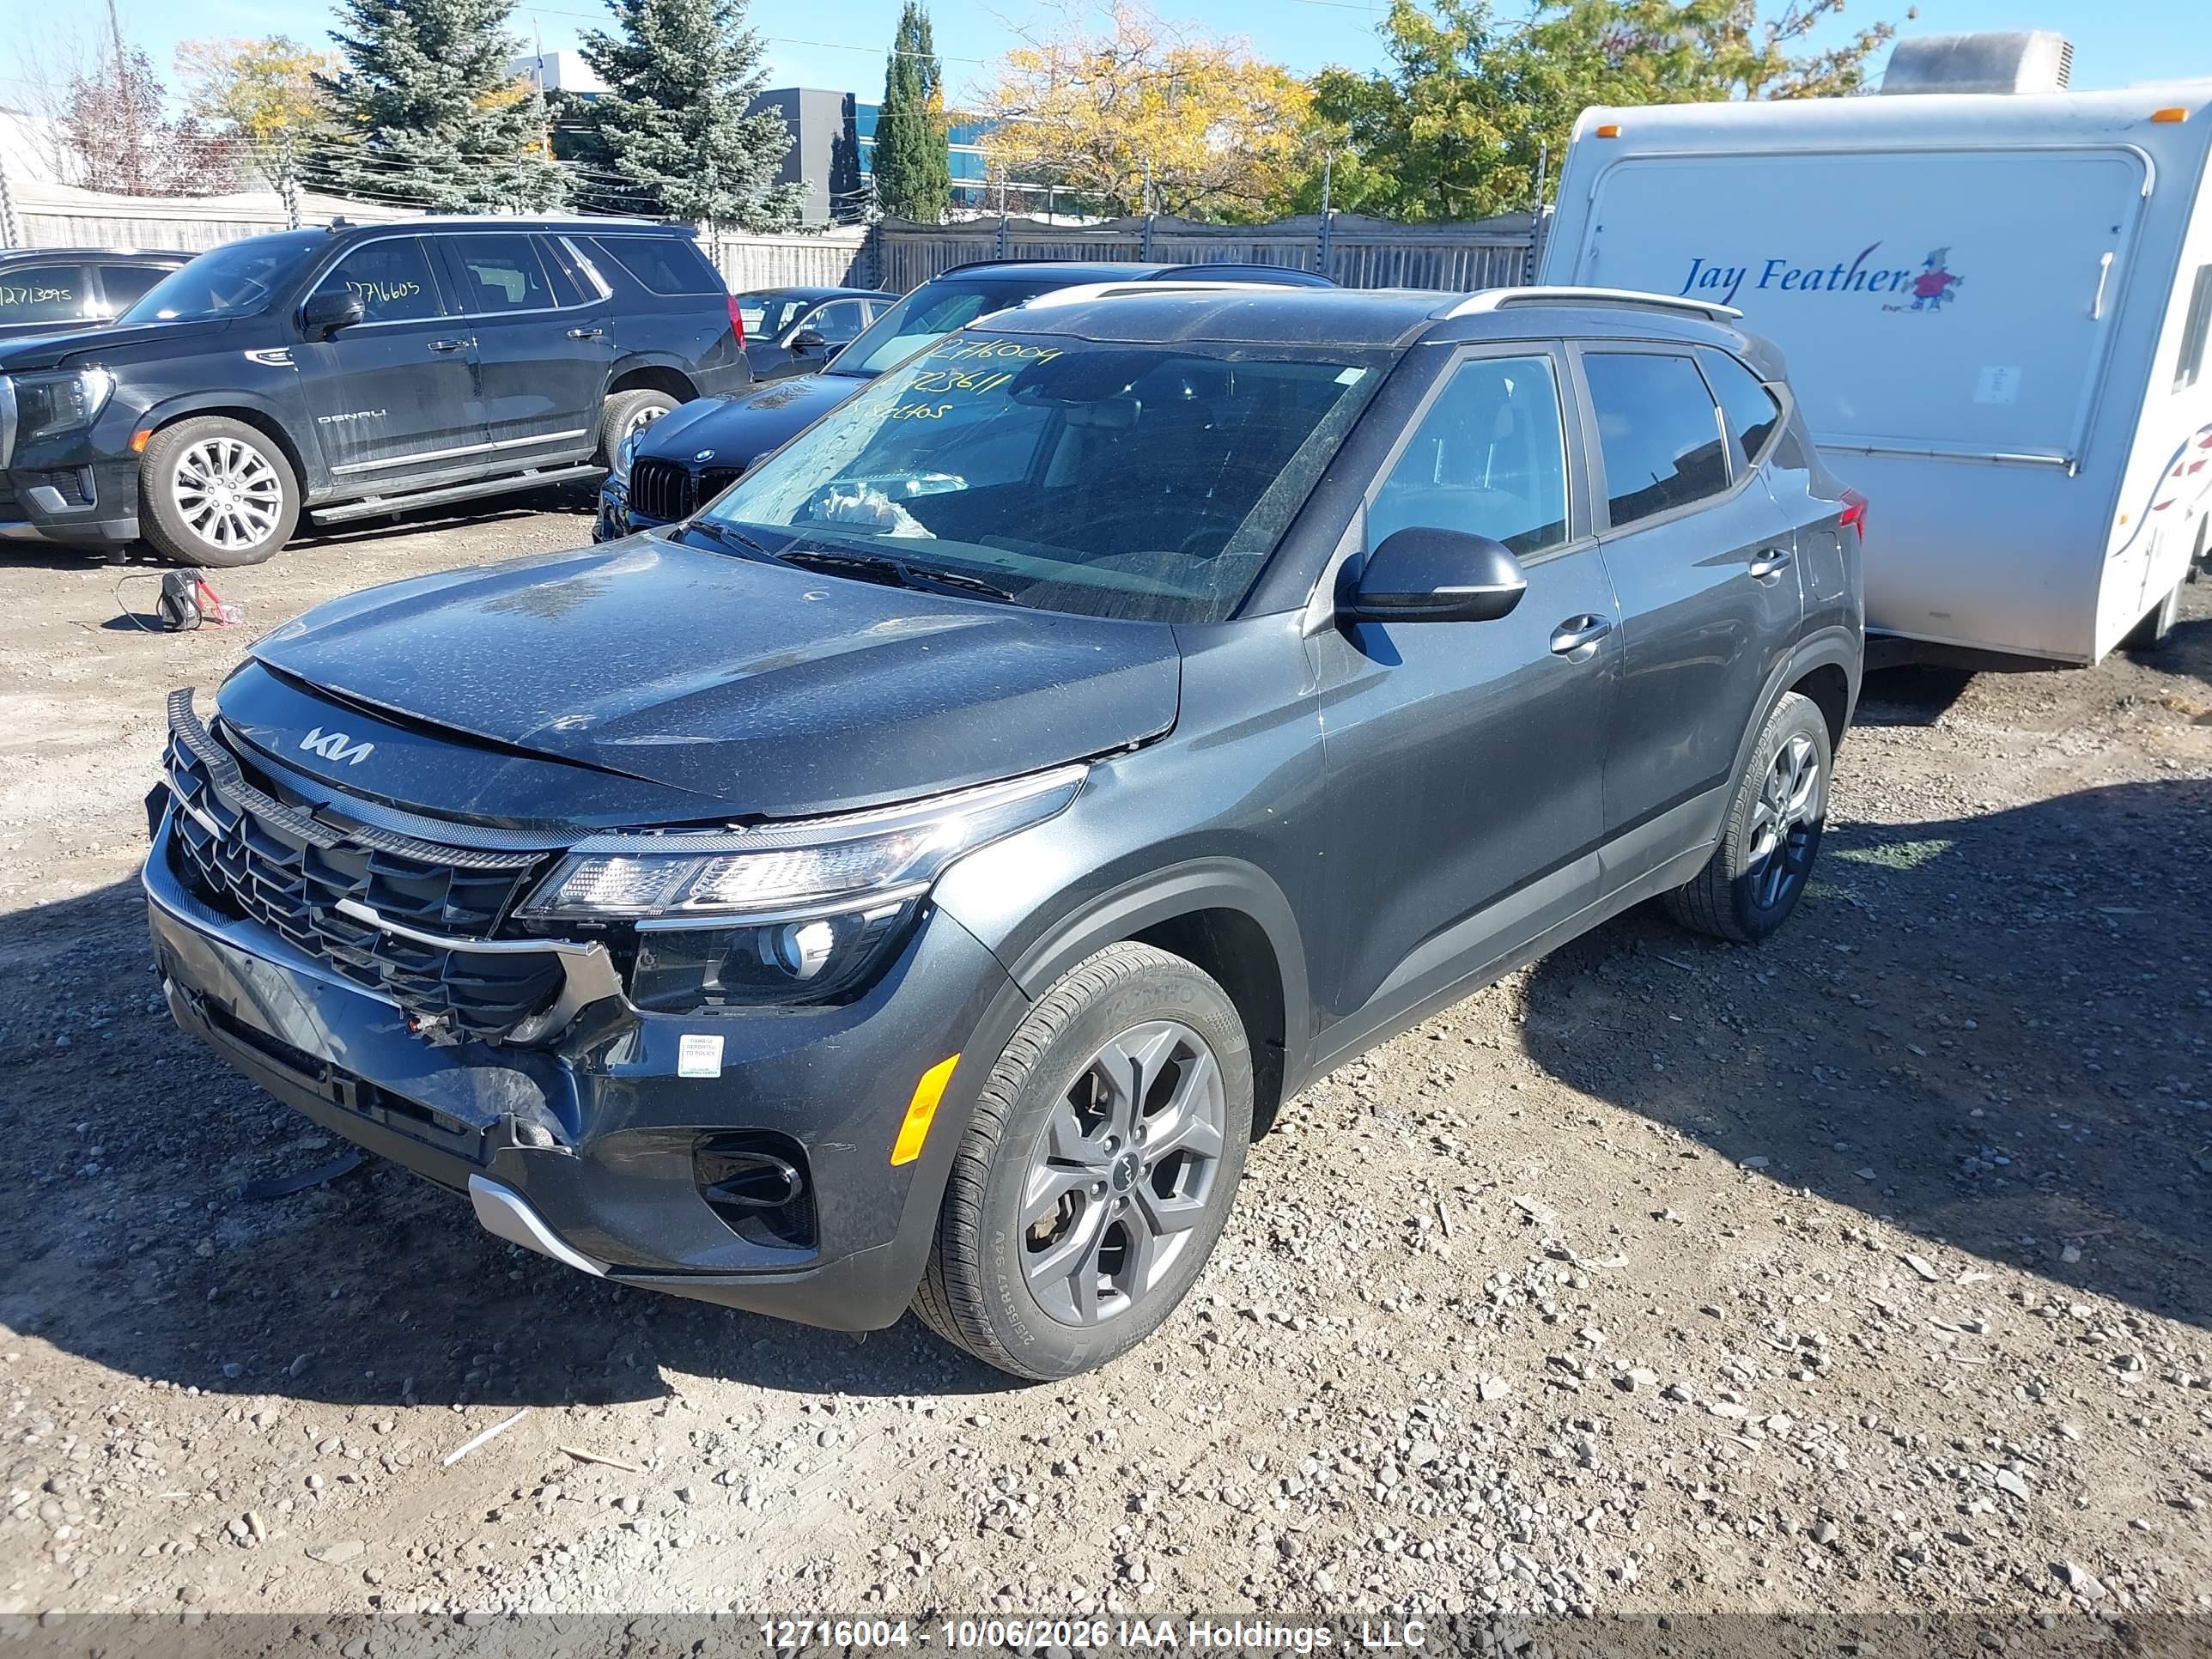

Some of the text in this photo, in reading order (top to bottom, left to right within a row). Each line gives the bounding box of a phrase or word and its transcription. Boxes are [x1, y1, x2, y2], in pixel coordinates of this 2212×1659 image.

[1678, 240, 1911, 306] Jay Feather
[0, 286, 72, 307] 12713095
[317, 409, 388, 424] DENALI
[299, 726, 375, 767] KIA
